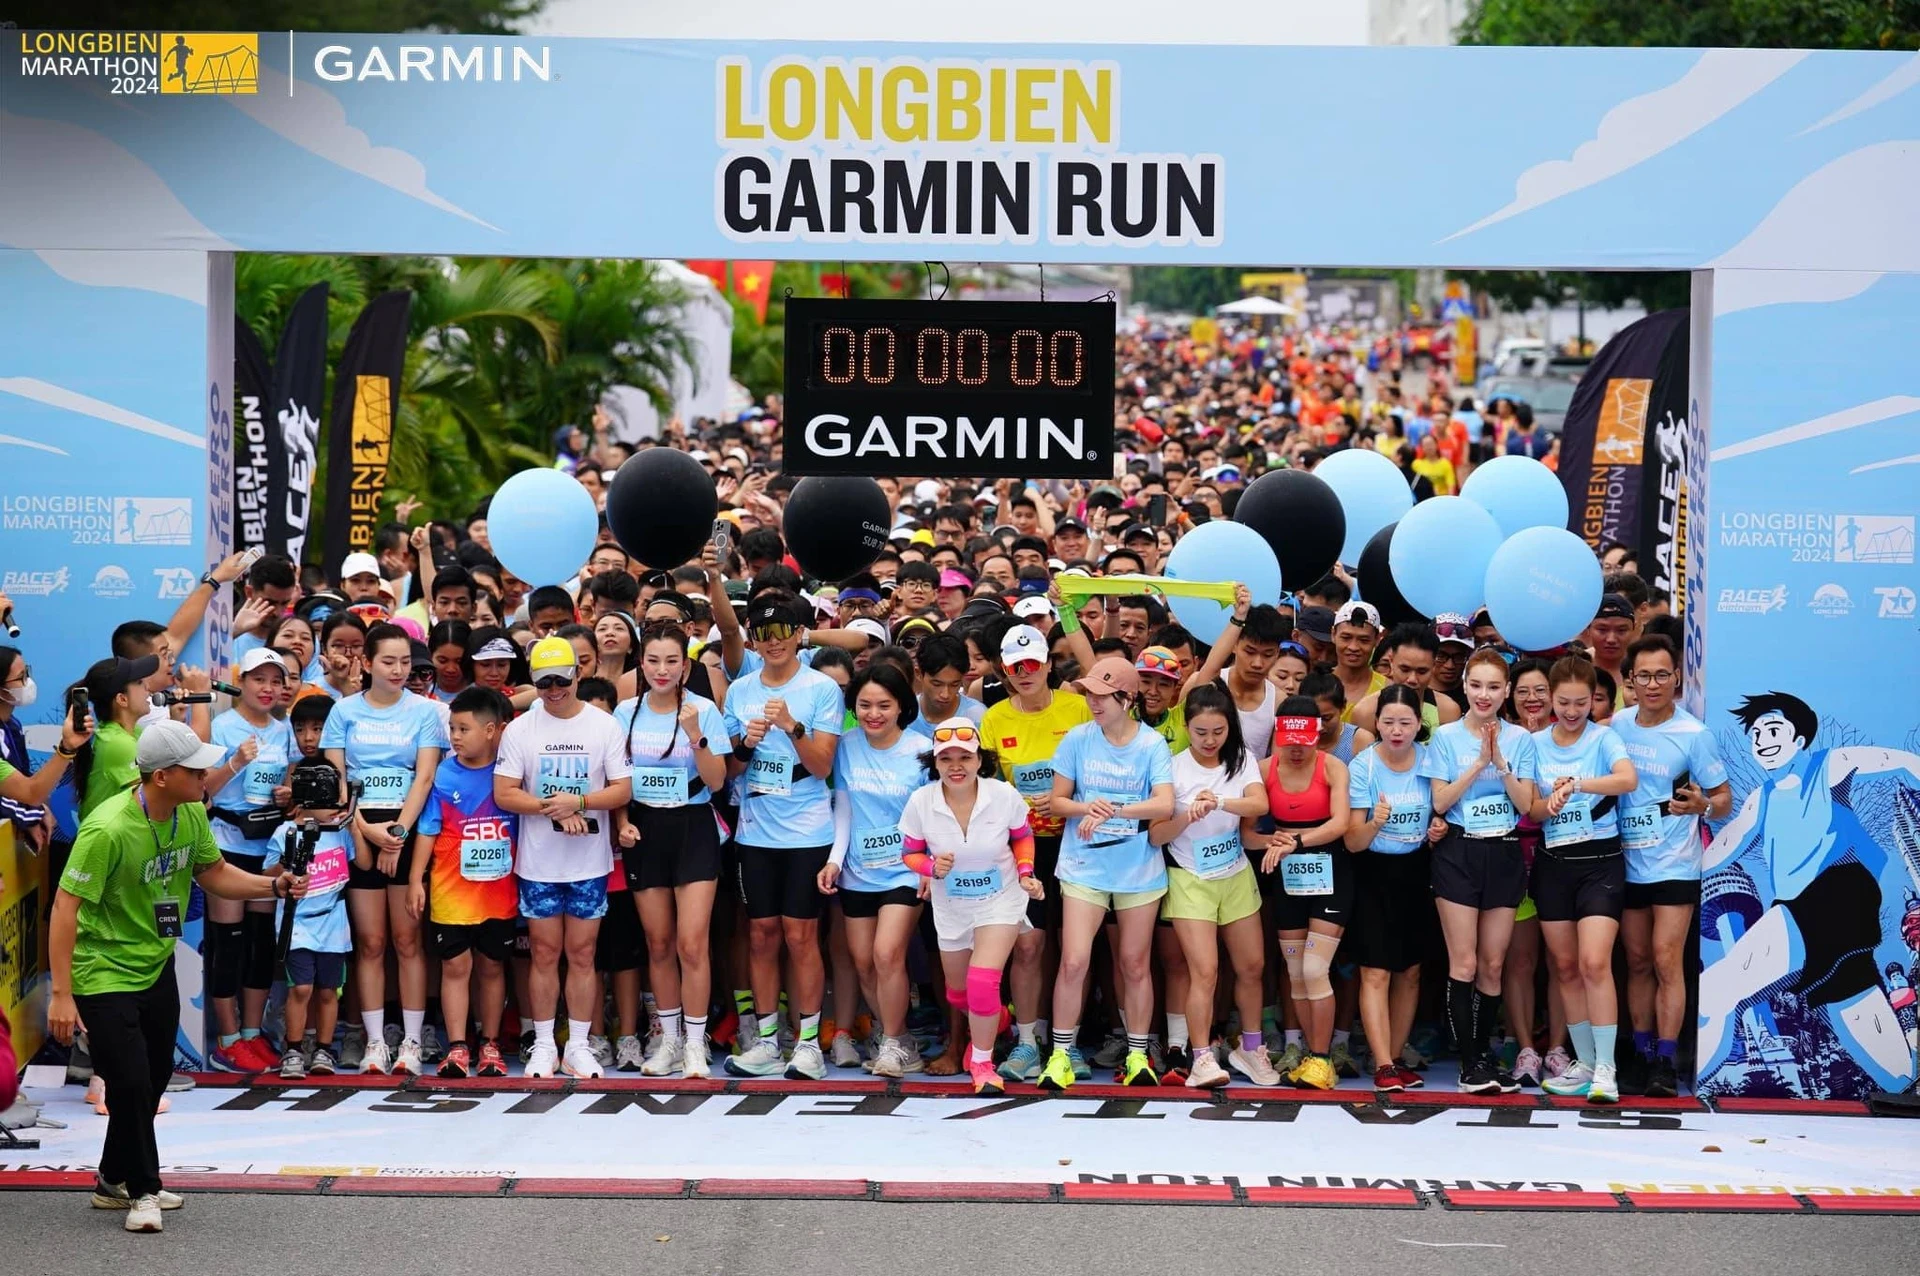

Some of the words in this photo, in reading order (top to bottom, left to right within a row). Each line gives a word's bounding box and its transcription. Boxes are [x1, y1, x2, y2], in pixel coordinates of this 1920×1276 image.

[724, 64, 1111, 142] LONGBIEN
[724, 156, 1030, 234] GARMIN
[1057, 162, 1215, 236] RUN
[210, 382, 220, 541] ZERO
[1687, 398, 1699, 557] ZERO
[3, 496, 112, 513] LONGBIEN
[350, 467, 372, 552] BIEN
[1695, 429, 1707, 593] HERO
[3, 514, 112, 530] MARATHON
[1721, 512, 1833, 531] LONGBIEN
[72, 532, 112, 545] 2024
[1720, 532, 1832, 548] MARATHON
[1791, 549, 1832, 562] 2024
[4, 572, 53, 584] RACE
[1720, 590, 1772, 603] RACE
[545, 744, 584, 752] GARMIN
[364, 776, 403, 788] 20873
[641, 776, 677, 787] 28517
[1020, 767, 1055, 782] 2056
[1472, 802, 1510, 817] 24930
[462, 821, 511, 841] SBC
[863, 832, 902, 850] 22300
[1202, 837, 1238, 858] 25209
[307, 857, 340, 876] 3474
[1287, 862, 1323, 874] 26365
[954, 876, 991, 888] 26199
